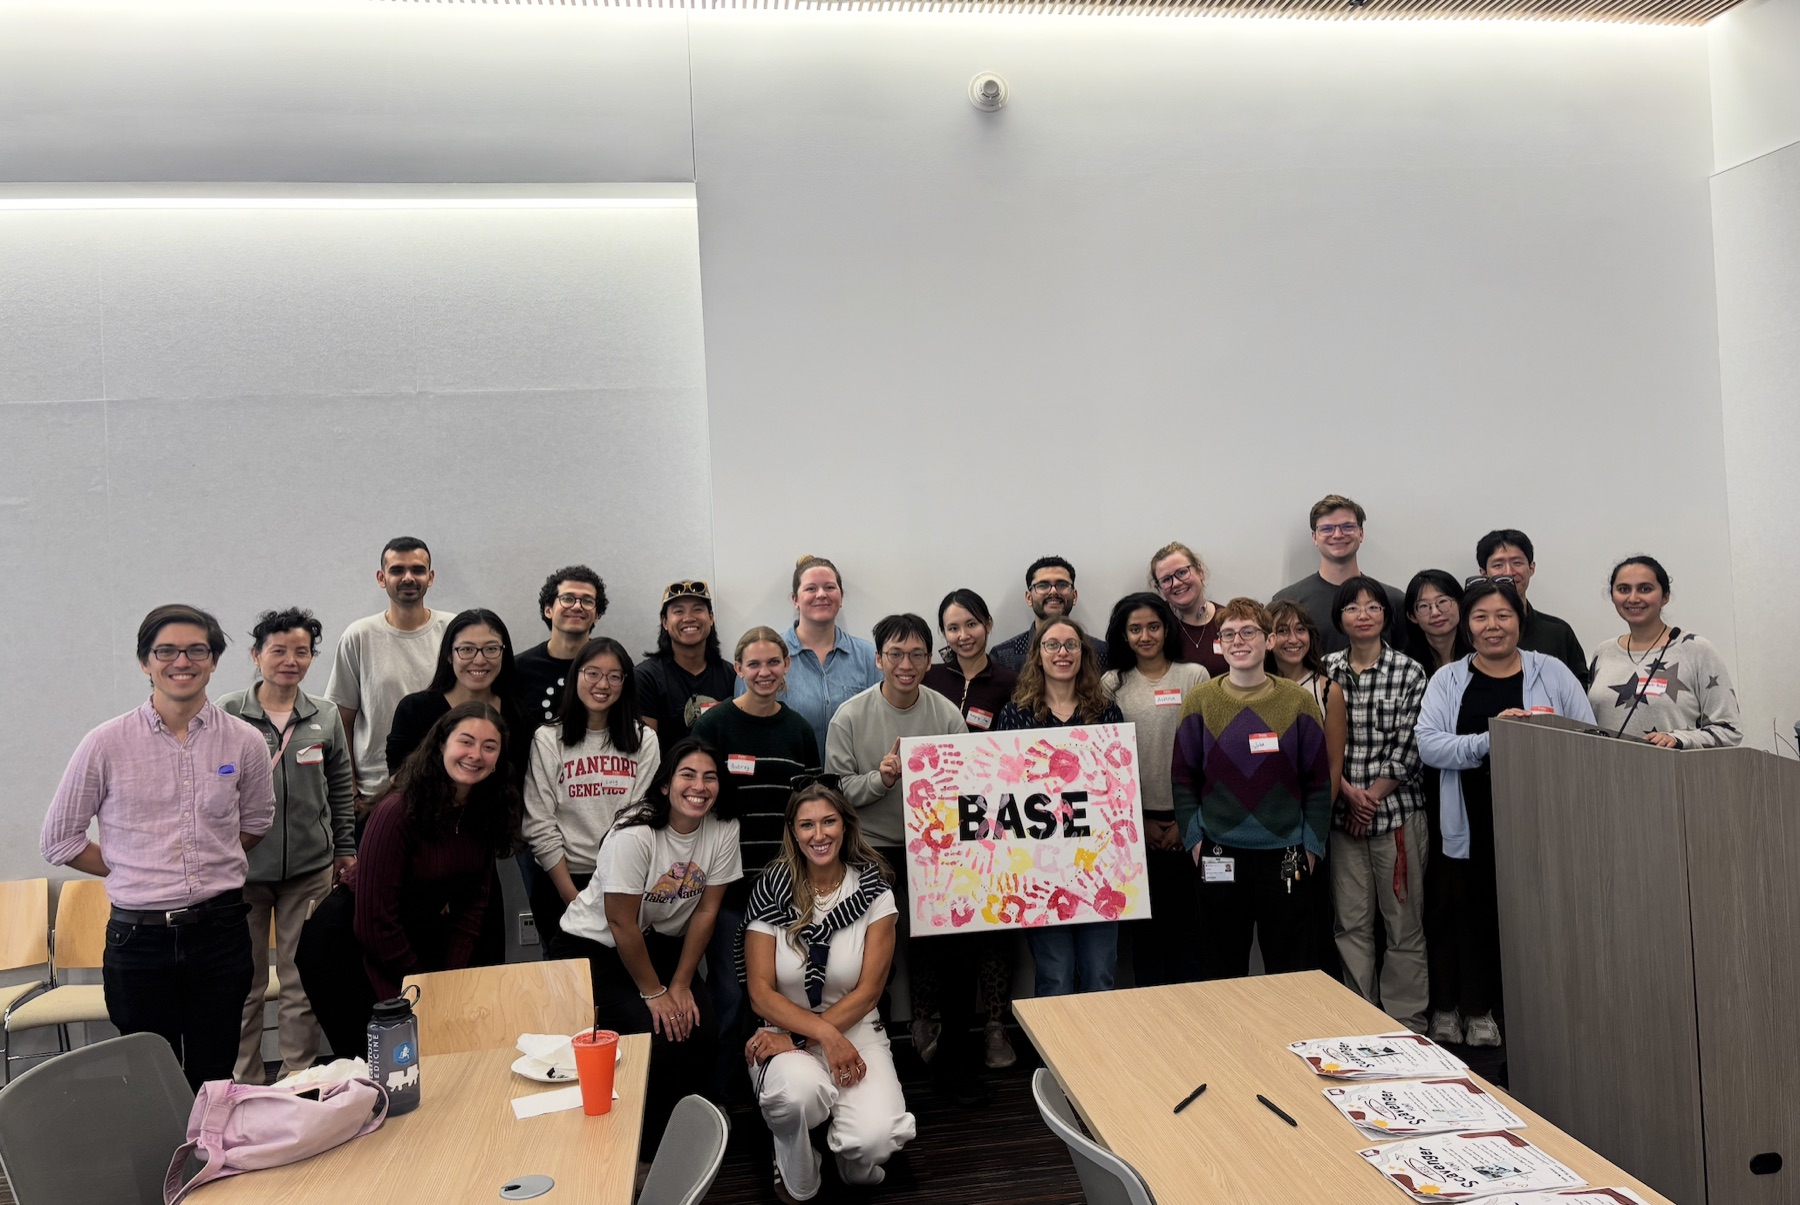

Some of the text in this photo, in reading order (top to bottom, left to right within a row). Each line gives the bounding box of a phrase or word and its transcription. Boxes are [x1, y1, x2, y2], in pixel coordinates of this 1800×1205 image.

[958, 791, 1091, 841] BASE
[1382, 1090, 1426, 1126] Scavenger
[1419, 1146, 1479, 1189] Scavenger
